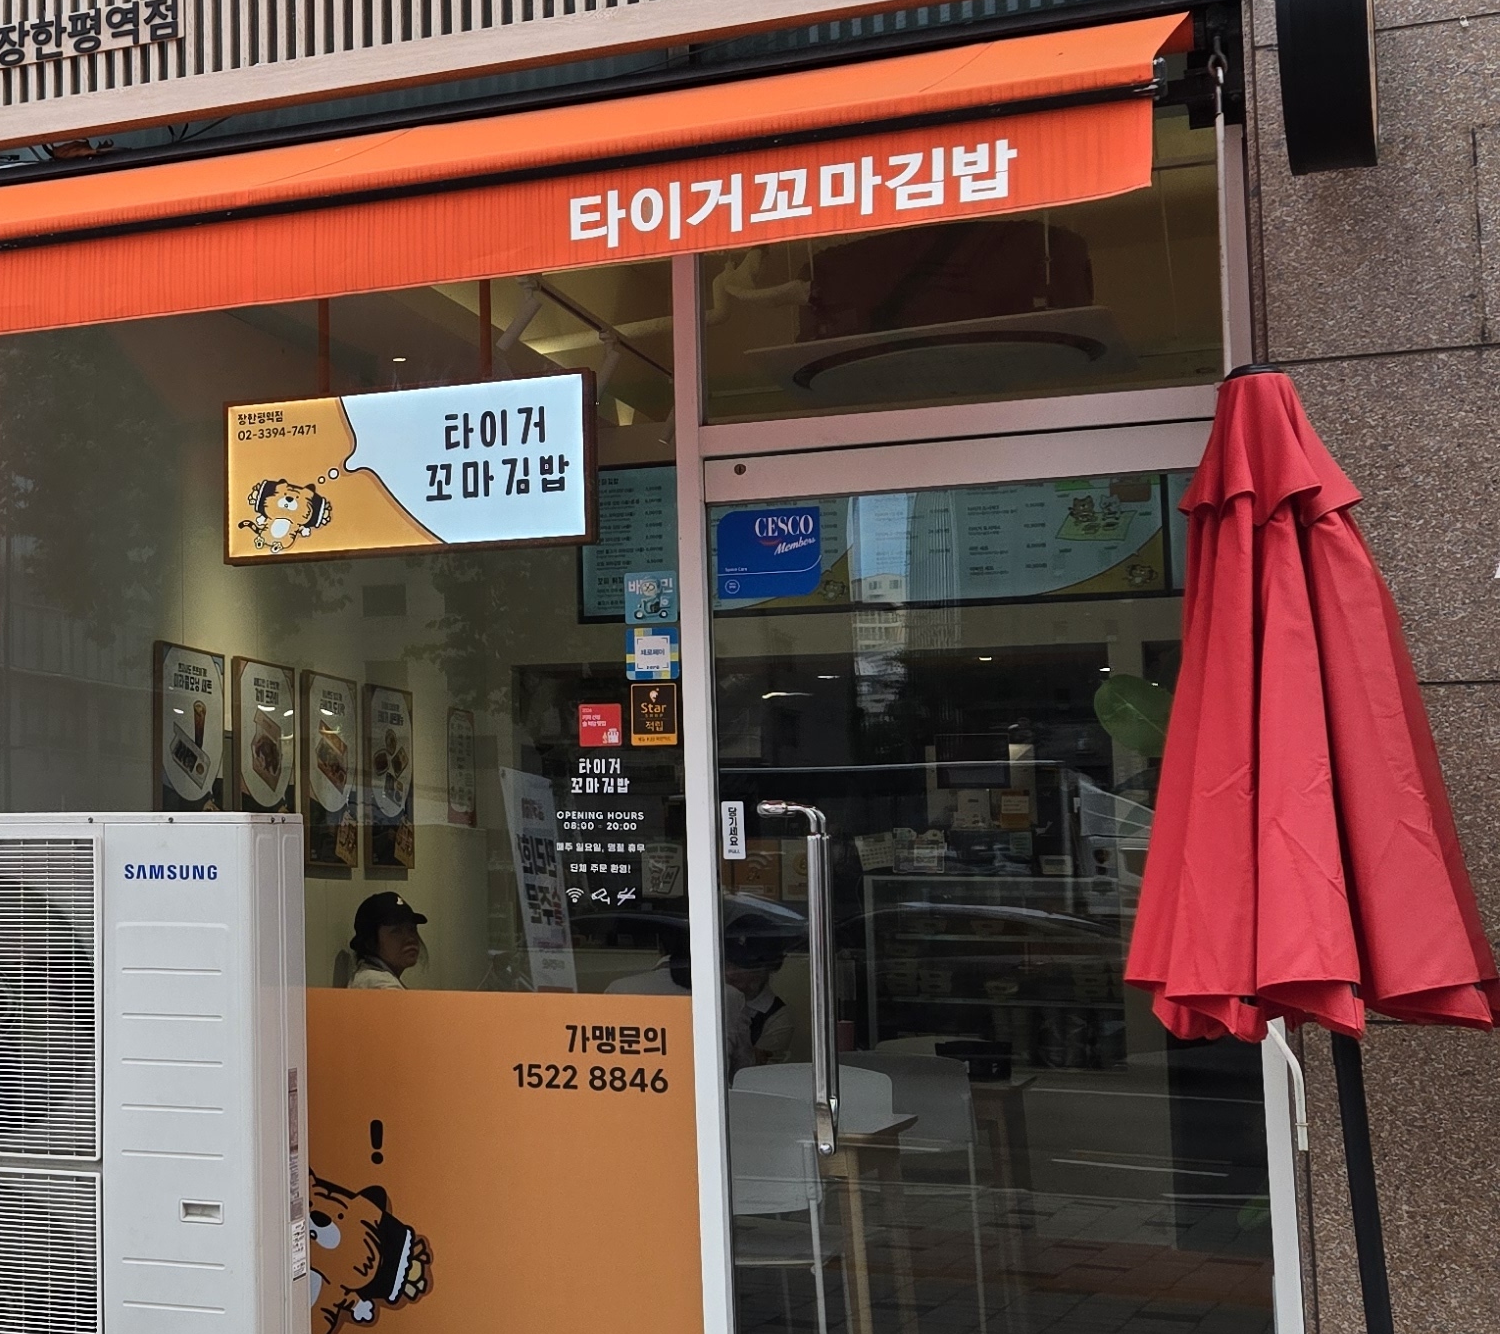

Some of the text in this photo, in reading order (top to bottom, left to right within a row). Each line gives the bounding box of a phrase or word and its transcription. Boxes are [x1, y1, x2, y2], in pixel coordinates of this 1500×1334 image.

[569, 140, 1018, 248] 타이거꼬마김밥
[238, 410, 284, 425] 장한평역점
[237, 424, 317, 441] 02-3394-7471
[444, 406, 546, 449] 타이거
[426, 454, 569, 501] 꼬마김밥
[755, 514, 814, 537] CESCO
[774, 536, 816, 555] Members
[640, 702, 667, 713] Star
[645, 721, 664, 732] 적립
[578, 758, 621, 774] 타이거
[570, 777, 630, 793] 꼬마김밥
[556, 811, 644, 820] OPENING HOURS
[563, 821, 637, 830] 08:00 20:00
[728, 807, 738, 846] 당기세요
[556, 842, 573, 851] 매주
[124, 863, 218, 881] SAMSUNG
[570, 864, 587, 872] 단체
[590, 864, 607, 873] 주문
[565, 1024, 667, 1056] 가맹문의
[512, 1063, 669, 1093] 1522 8846
